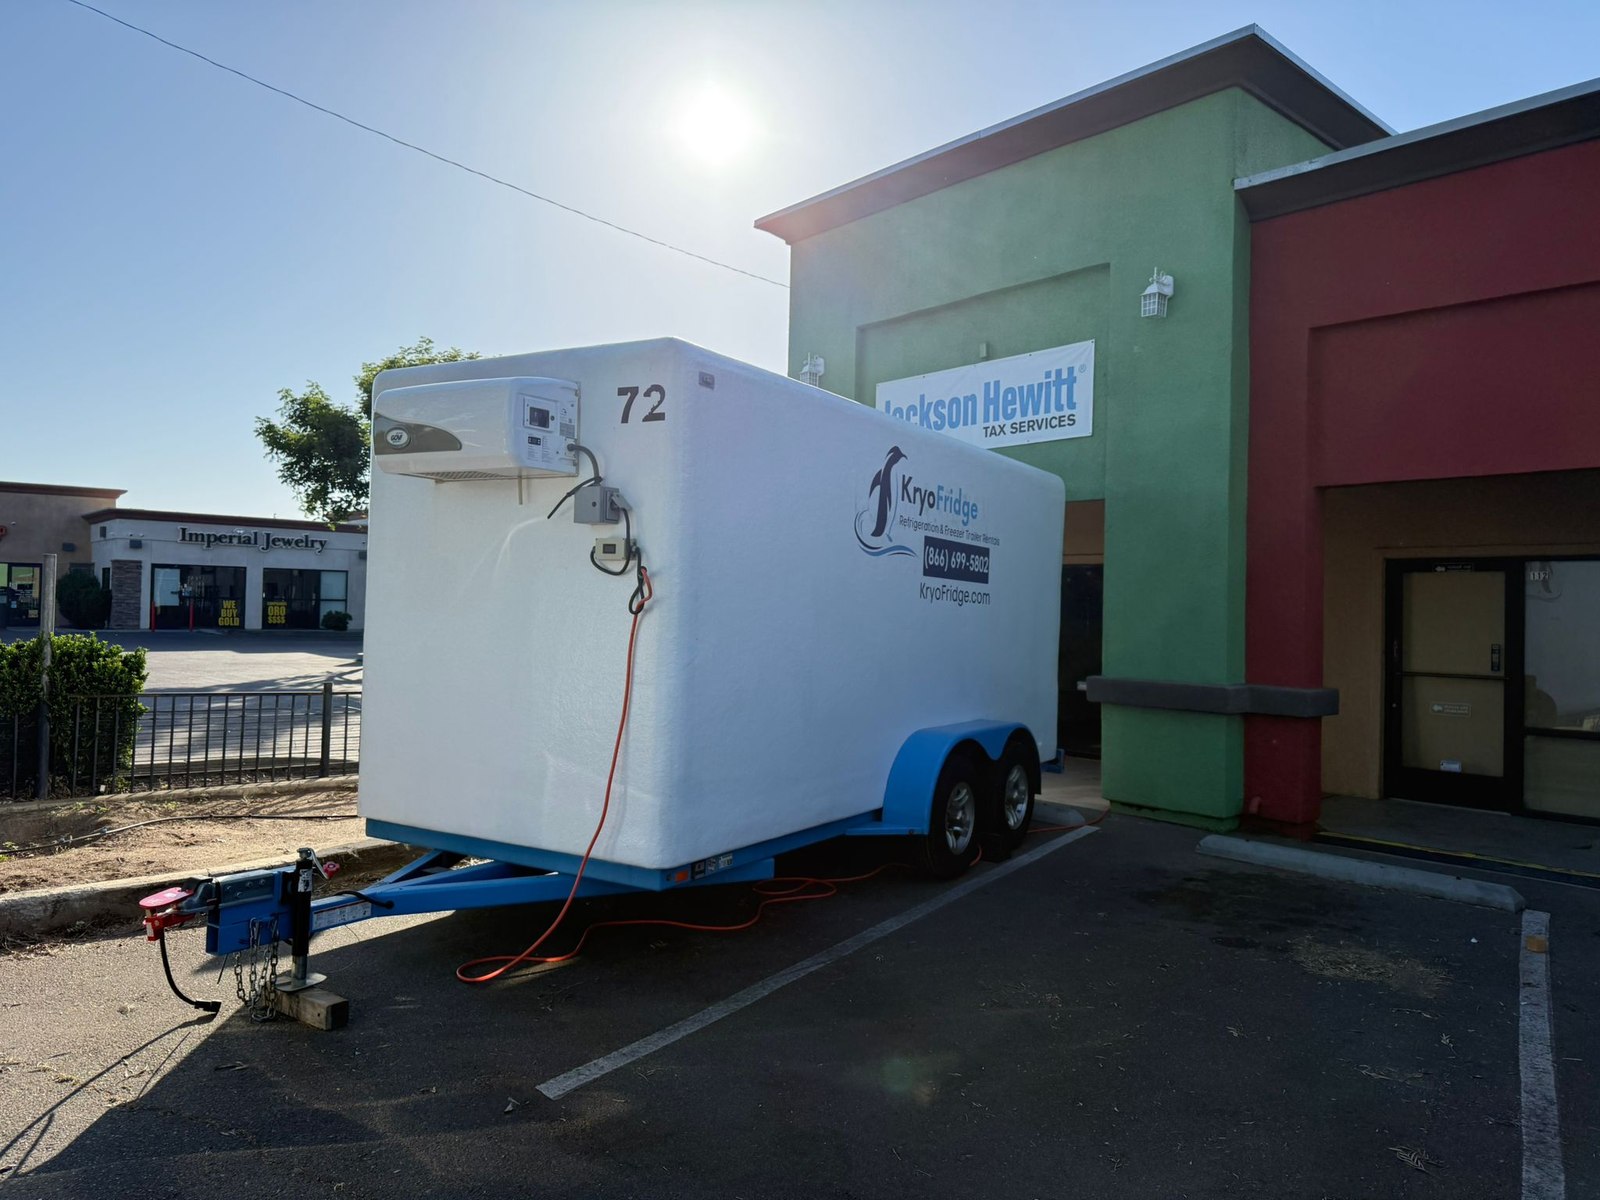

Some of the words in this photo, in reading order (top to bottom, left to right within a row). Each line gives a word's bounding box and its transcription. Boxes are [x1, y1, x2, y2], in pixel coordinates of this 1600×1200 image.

[617, 384, 666, 424] 72
[983, 366, 1077, 424] Hewitt
[983, 424, 1006, 438] TAX
[1009, 414, 1076, 434] SERVICES
[901, 474, 978, 526] KryoFridge
[179, 527, 258, 548] Imperial
[261, 532, 328, 554] Jewelry
[900, 515, 940, 533] Refrigeration
[944, 525, 965, 538] Freezer
[965, 530, 982, 542] Trailer
[982, 533, 1000, 546] Rentals
[925, 545, 949, 572] (866)
[951, 551, 989, 573] 699-5802
[223, 600, 236, 609] WE
[920, 582, 991, 607] KryoFridge.com
[218, 617, 240, 626] GOLD
[221, 608, 238, 617] BUY
[267, 606, 286, 616] ORO
